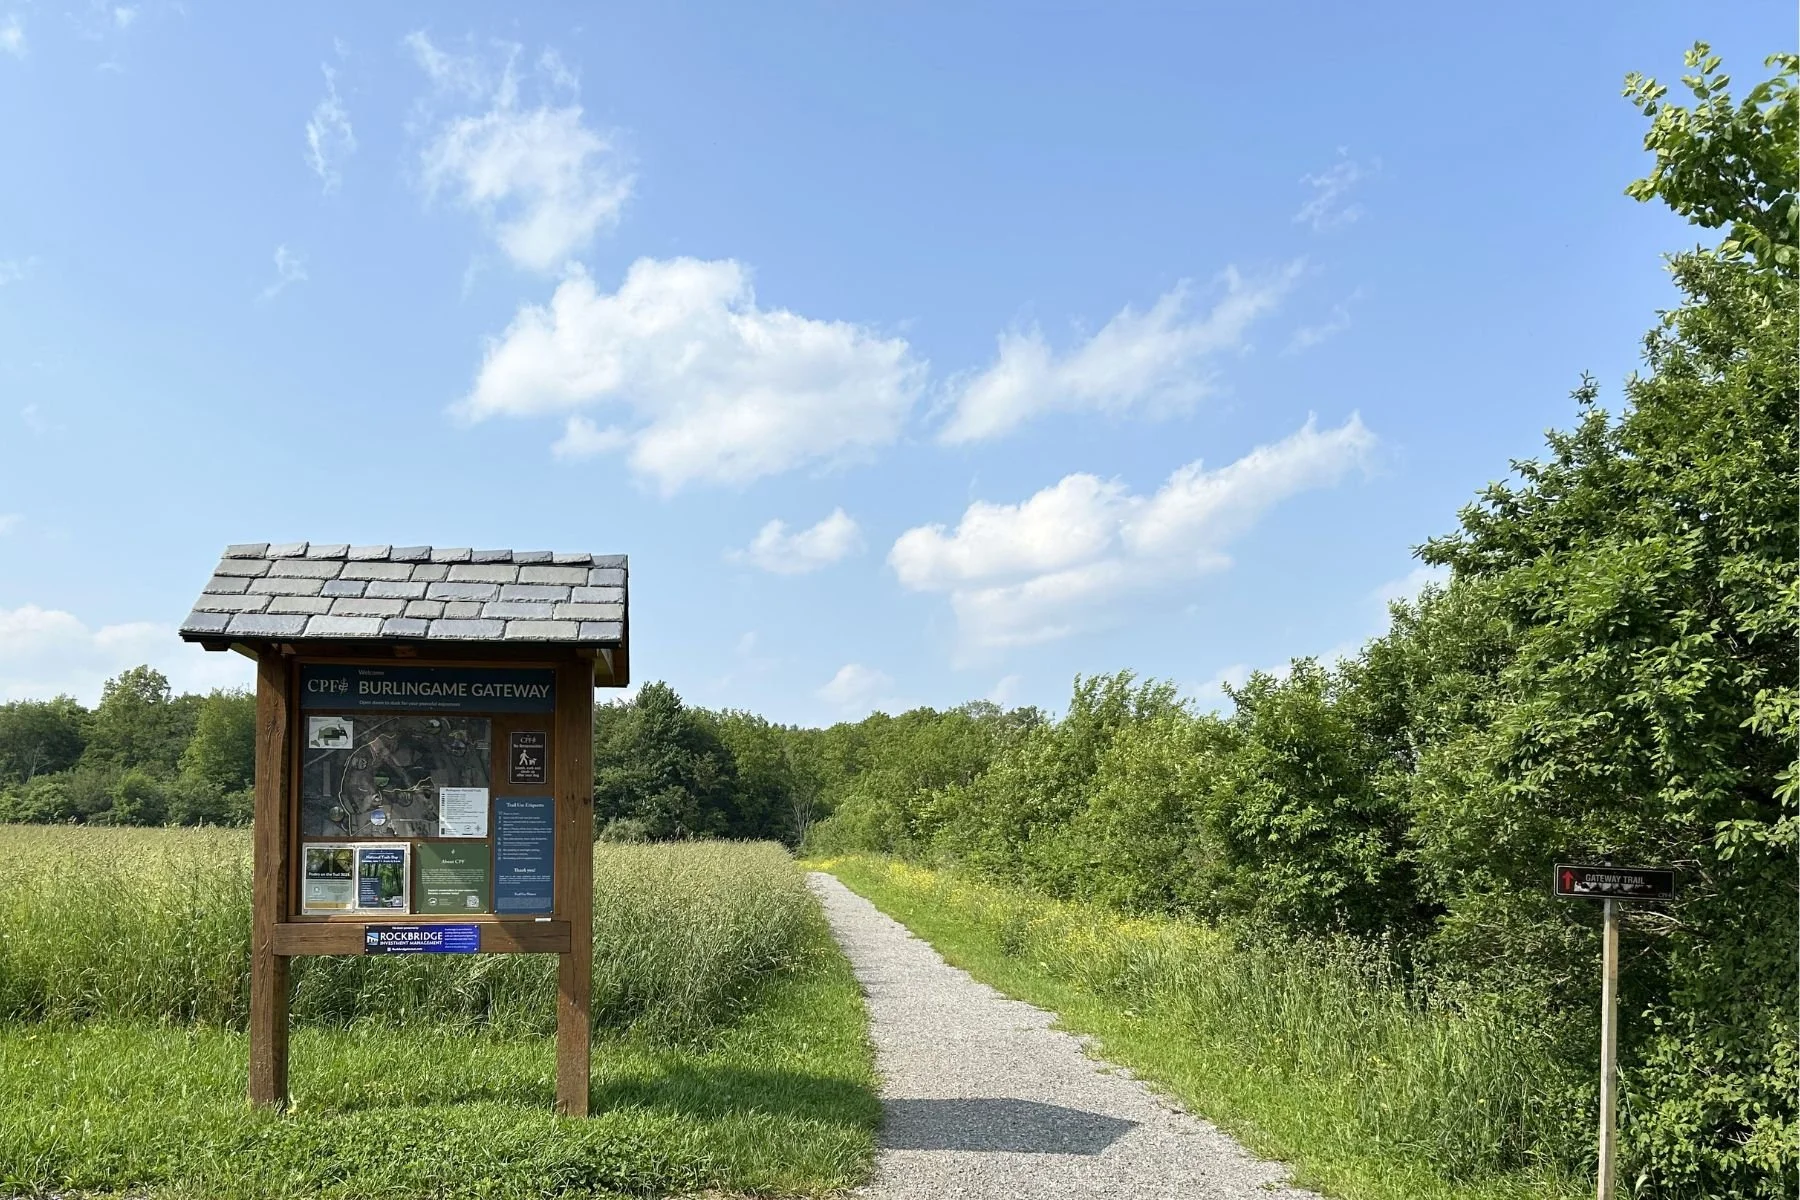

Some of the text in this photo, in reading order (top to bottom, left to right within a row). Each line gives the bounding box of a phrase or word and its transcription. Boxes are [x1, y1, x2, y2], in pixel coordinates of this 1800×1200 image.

[307, 679, 339, 692] CPF
[359, 681, 550, 698] BURLINGAME GATEWAY
[1585, 873, 1645, 885] GATEWAY TRAIL
[380, 932, 443, 941] ROCKBRIDGE
